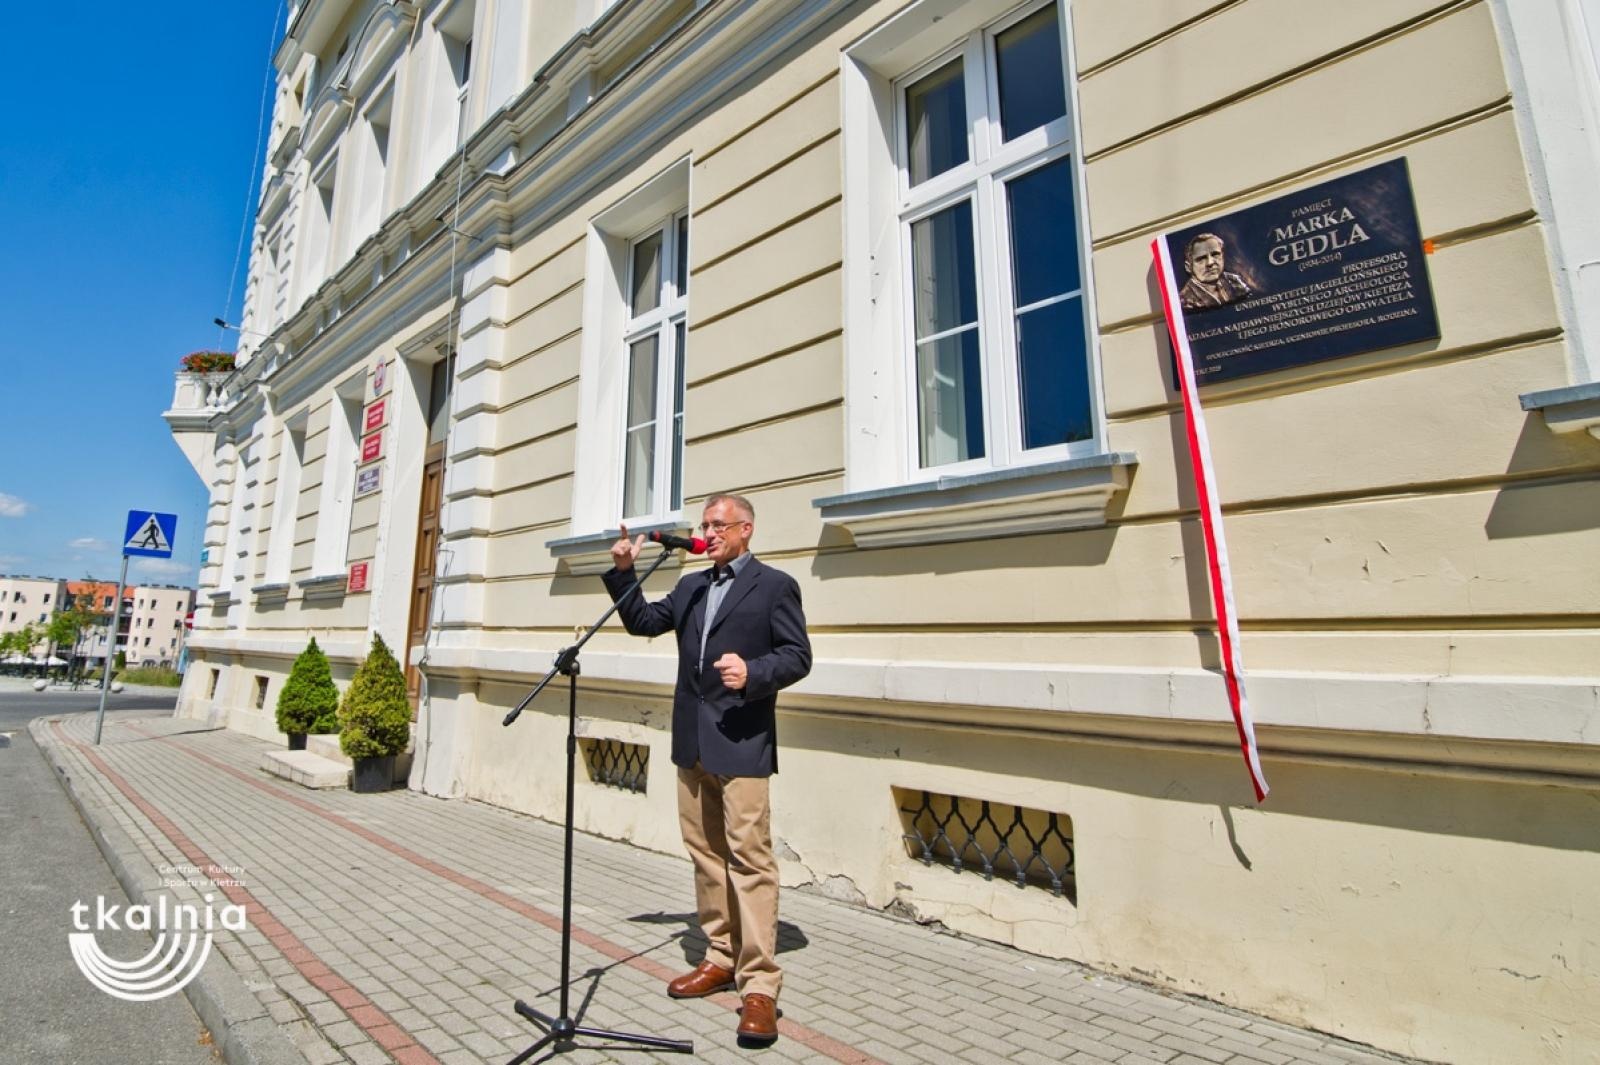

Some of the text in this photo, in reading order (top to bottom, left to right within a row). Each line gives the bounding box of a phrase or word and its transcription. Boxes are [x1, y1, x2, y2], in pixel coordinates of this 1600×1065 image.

[1268, 223, 1370, 267] GEDLA
[1274, 207, 1355, 242] MARKA
[1342, 249, 1407, 274] PROFESORA
[1224, 304, 1314, 334] NAJDAWNIEJSZYCH
[1315, 293, 1361, 311] DZIEJÓW
[1363, 279, 1412, 299] KIETRZA
[1234, 260, 1408, 312] UNIWERSYTETU JAGIELLOŃSKIEGO
[1271, 269, 1410, 312] WYBITNEGO ARCHEOLOGA
[1241, 325, 1267, 339] JEGO
[1268, 306, 1344, 332] HONOROWEGO
[1344, 289, 1414, 314] OBYWATELA
